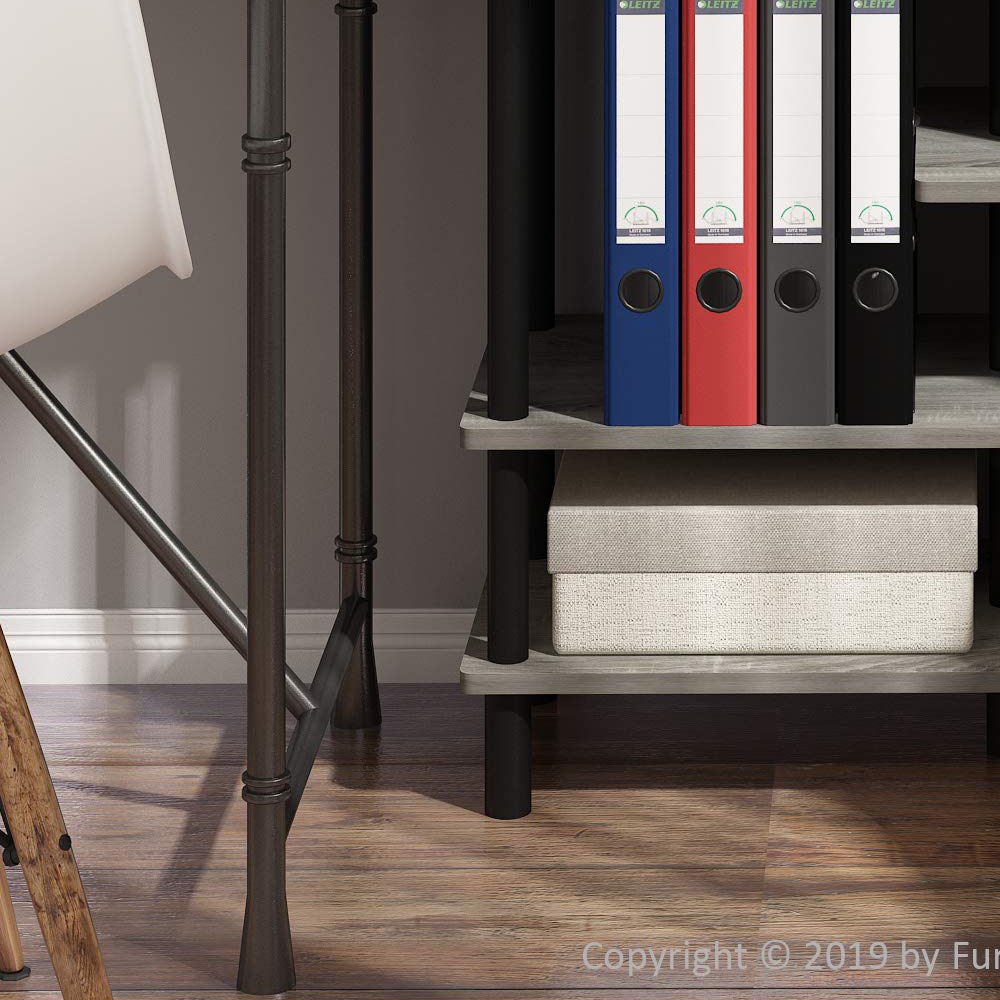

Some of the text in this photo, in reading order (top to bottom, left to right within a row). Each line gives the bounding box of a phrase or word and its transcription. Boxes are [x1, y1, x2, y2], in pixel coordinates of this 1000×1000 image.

[628, 0, 661, 9] LEITZ
[706, 0, 739, 9] LEITZ
[784, 0, 817, 9] LEITZ
[862, 0, 895, 9] LEITZ
